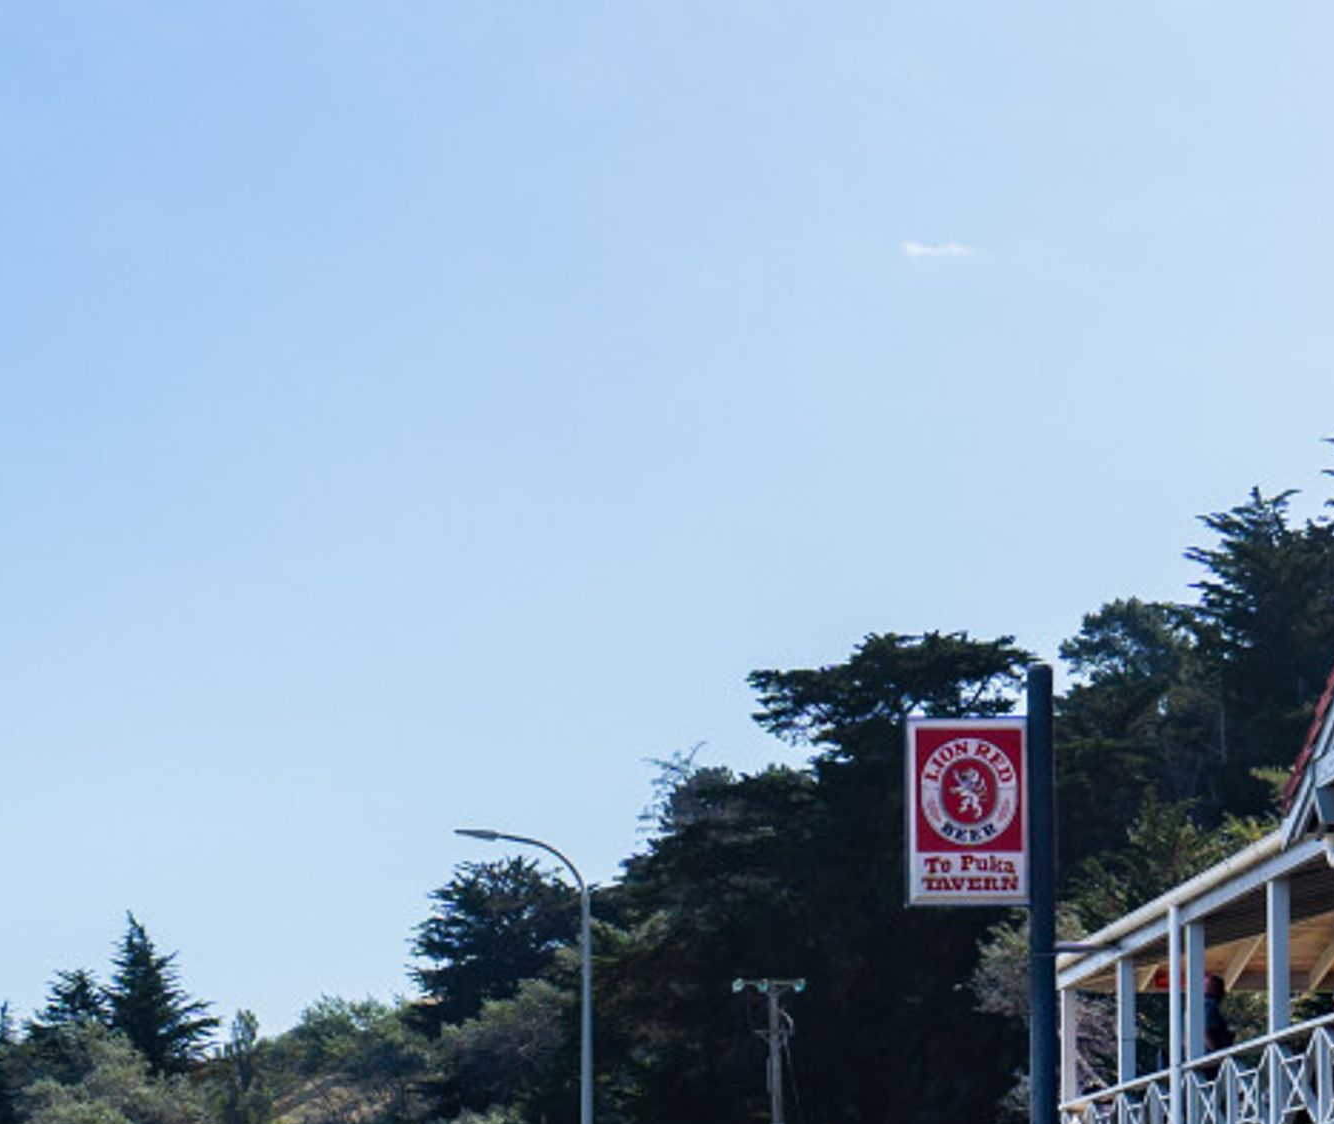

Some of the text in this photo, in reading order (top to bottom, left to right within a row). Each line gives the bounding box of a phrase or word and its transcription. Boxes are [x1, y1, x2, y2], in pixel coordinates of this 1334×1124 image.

[925, 741, 1013, 783] LION RED
[941, 822, 997, 842] BEER
[925, 855, 1016, 874] Te Puka
[922, 876, 1019, 891] TAVERN
